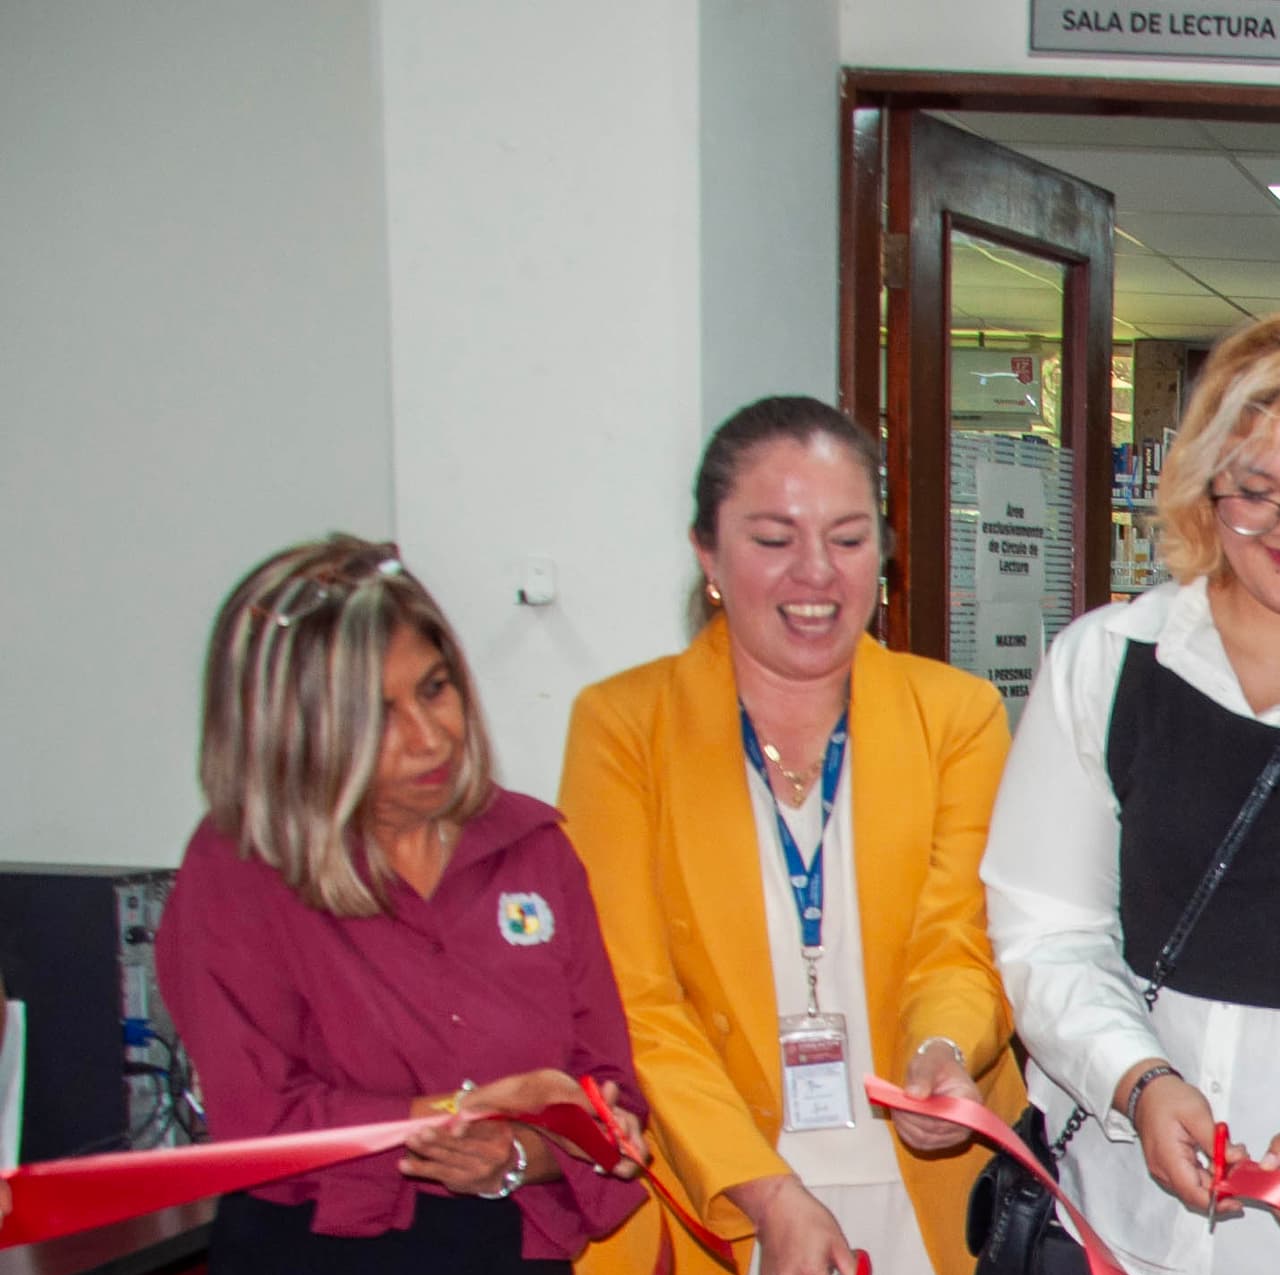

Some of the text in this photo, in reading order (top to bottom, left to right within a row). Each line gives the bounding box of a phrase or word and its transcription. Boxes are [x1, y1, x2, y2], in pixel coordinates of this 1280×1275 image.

[1062, 9, 1276, 39] SALA DE LECTURA
